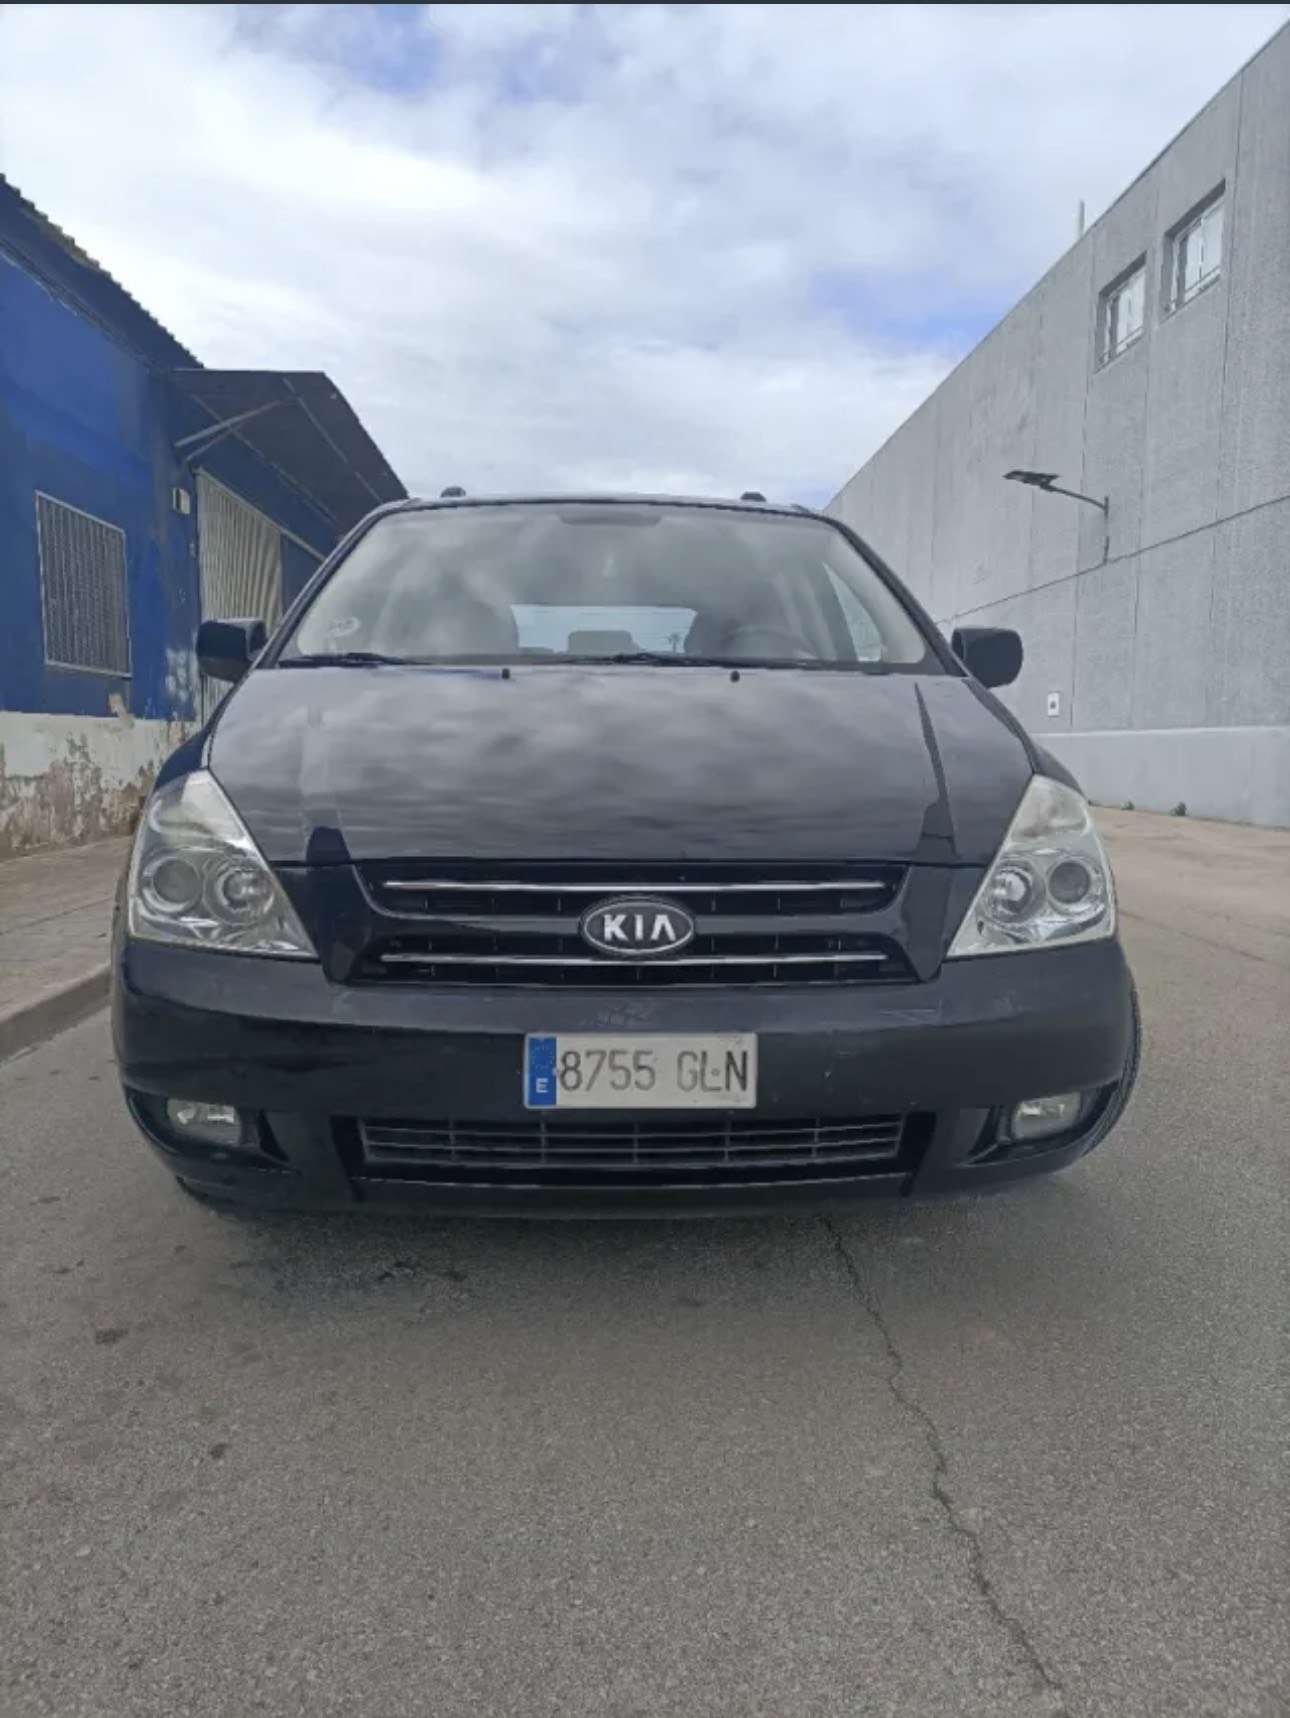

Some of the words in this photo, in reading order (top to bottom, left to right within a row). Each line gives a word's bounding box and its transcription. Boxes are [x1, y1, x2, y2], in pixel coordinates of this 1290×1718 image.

[603, 914, 676, 941] KIA
[560, 1050, 655, 1091] 8755
[677, 1050, 748, 1092] GLN
[536, 1078, 548, 1093] E
